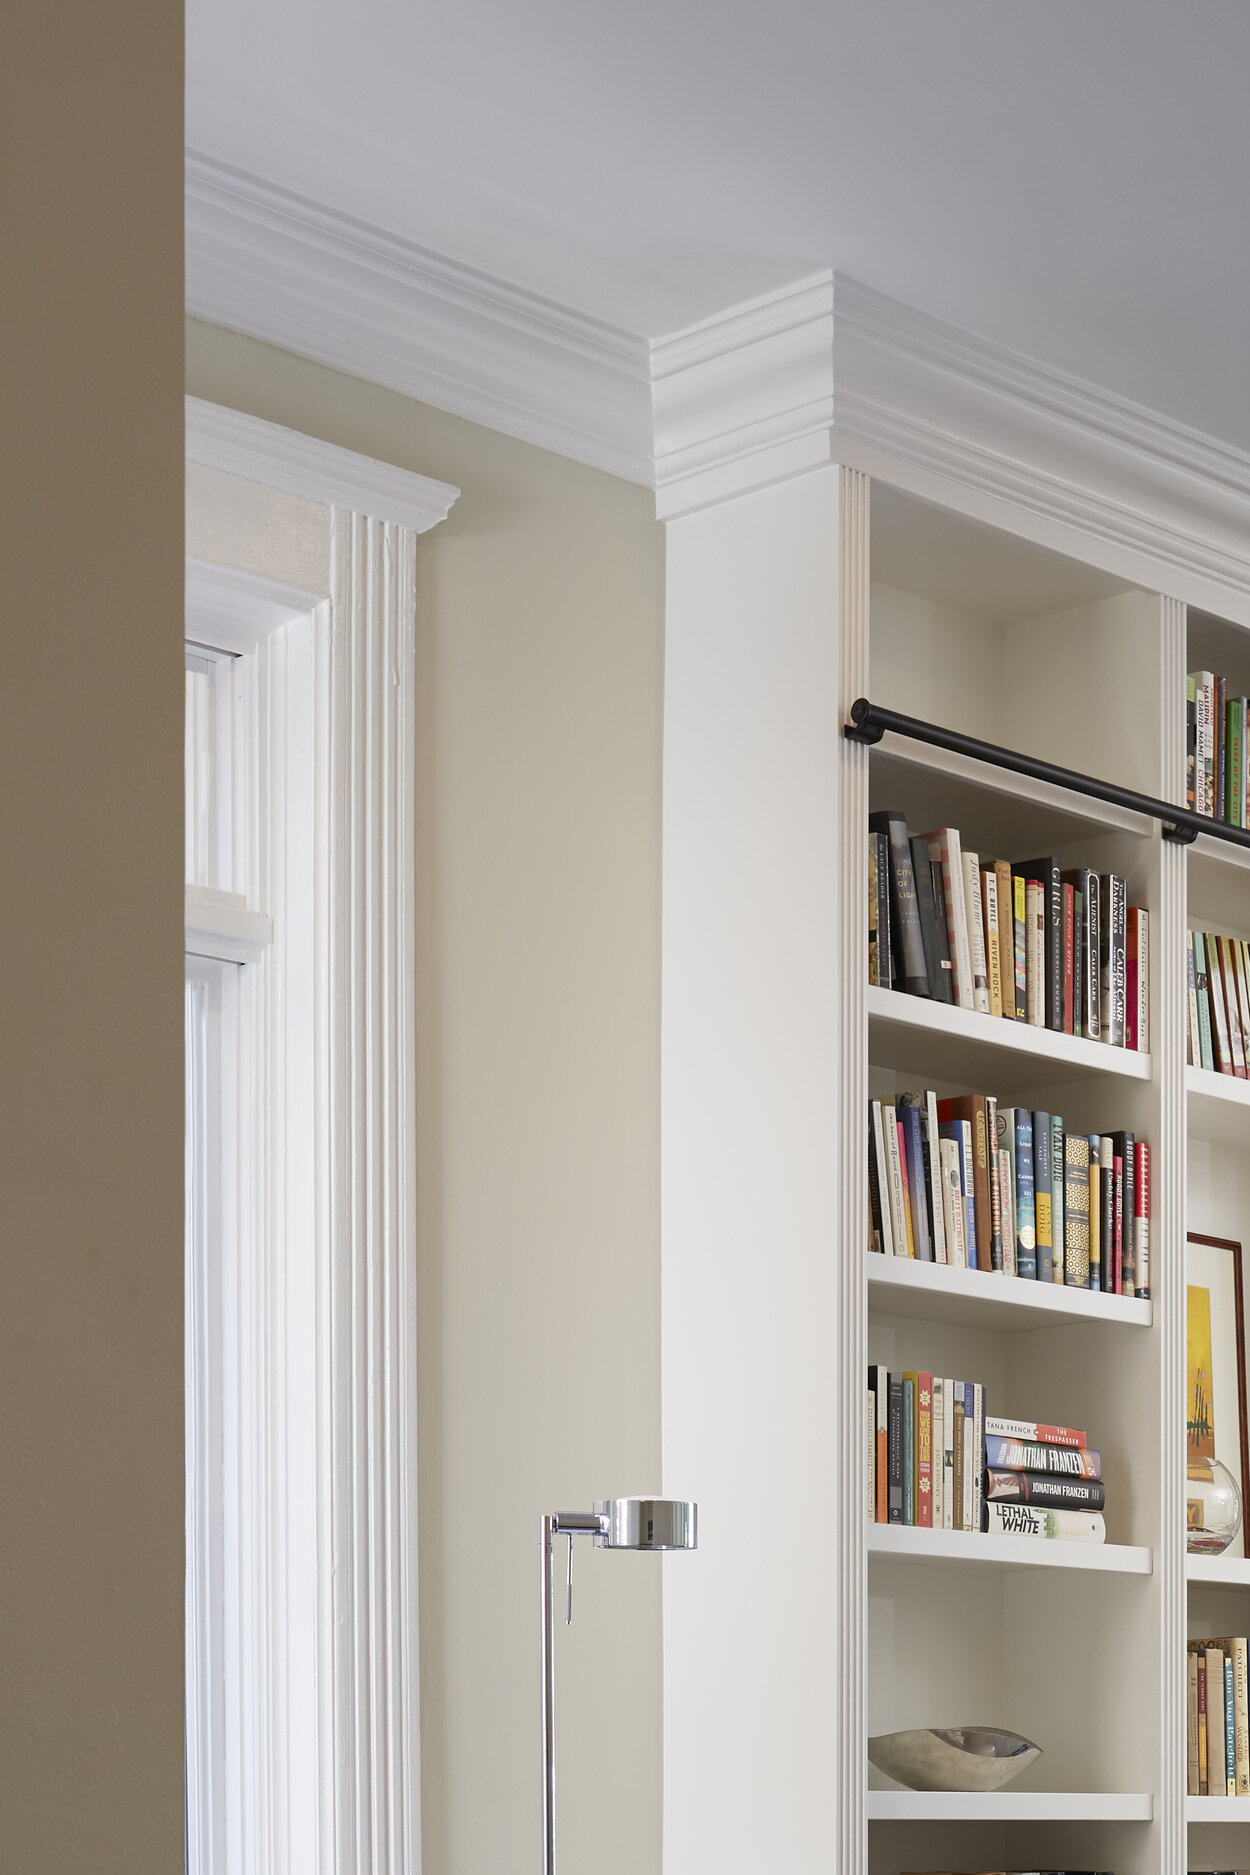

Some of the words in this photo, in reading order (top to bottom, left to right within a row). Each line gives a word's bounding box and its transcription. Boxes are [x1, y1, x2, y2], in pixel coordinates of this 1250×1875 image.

[1233, 766, 1238, 778] OF
[970, 860, 979, 887] Judy
[973, 891, 981, 927] Blume
[1052, 867, 1061, 927] GIRLS
[989, 899, 997, 922] BOYLE
[992, 973, 1000, 999] ROCK
[1116, 989, 1124, 1022] CARR
[1054, 1124, 1062, 1154] IVAN
[1054, 1157, 1062, 1183] DOIG
[987, 1422, 1004, 1430] TANA
[1007, 1425, 1031, 1434] FRENCH
[1045, 1434, 1079, 1445] TRESPASSER
[1057, 1428, 1067, 1436] THE
[1006, 1443, 1047, 1470] JONATHAN
[1049, 1449, 1085, 1475] FRANZEN
[1032, 1482, 1061, 1495] JONATHAN
[1062, 1487, 1089, 1499] FRANZEN
[996, 1504, 1034, 1519] LETHAL
[1002, 1517, 1040, 1534] WHITE
[1227, 1700, 1235, 1721] Ann
[1227, 1726, 1235, 1776] Patchett
